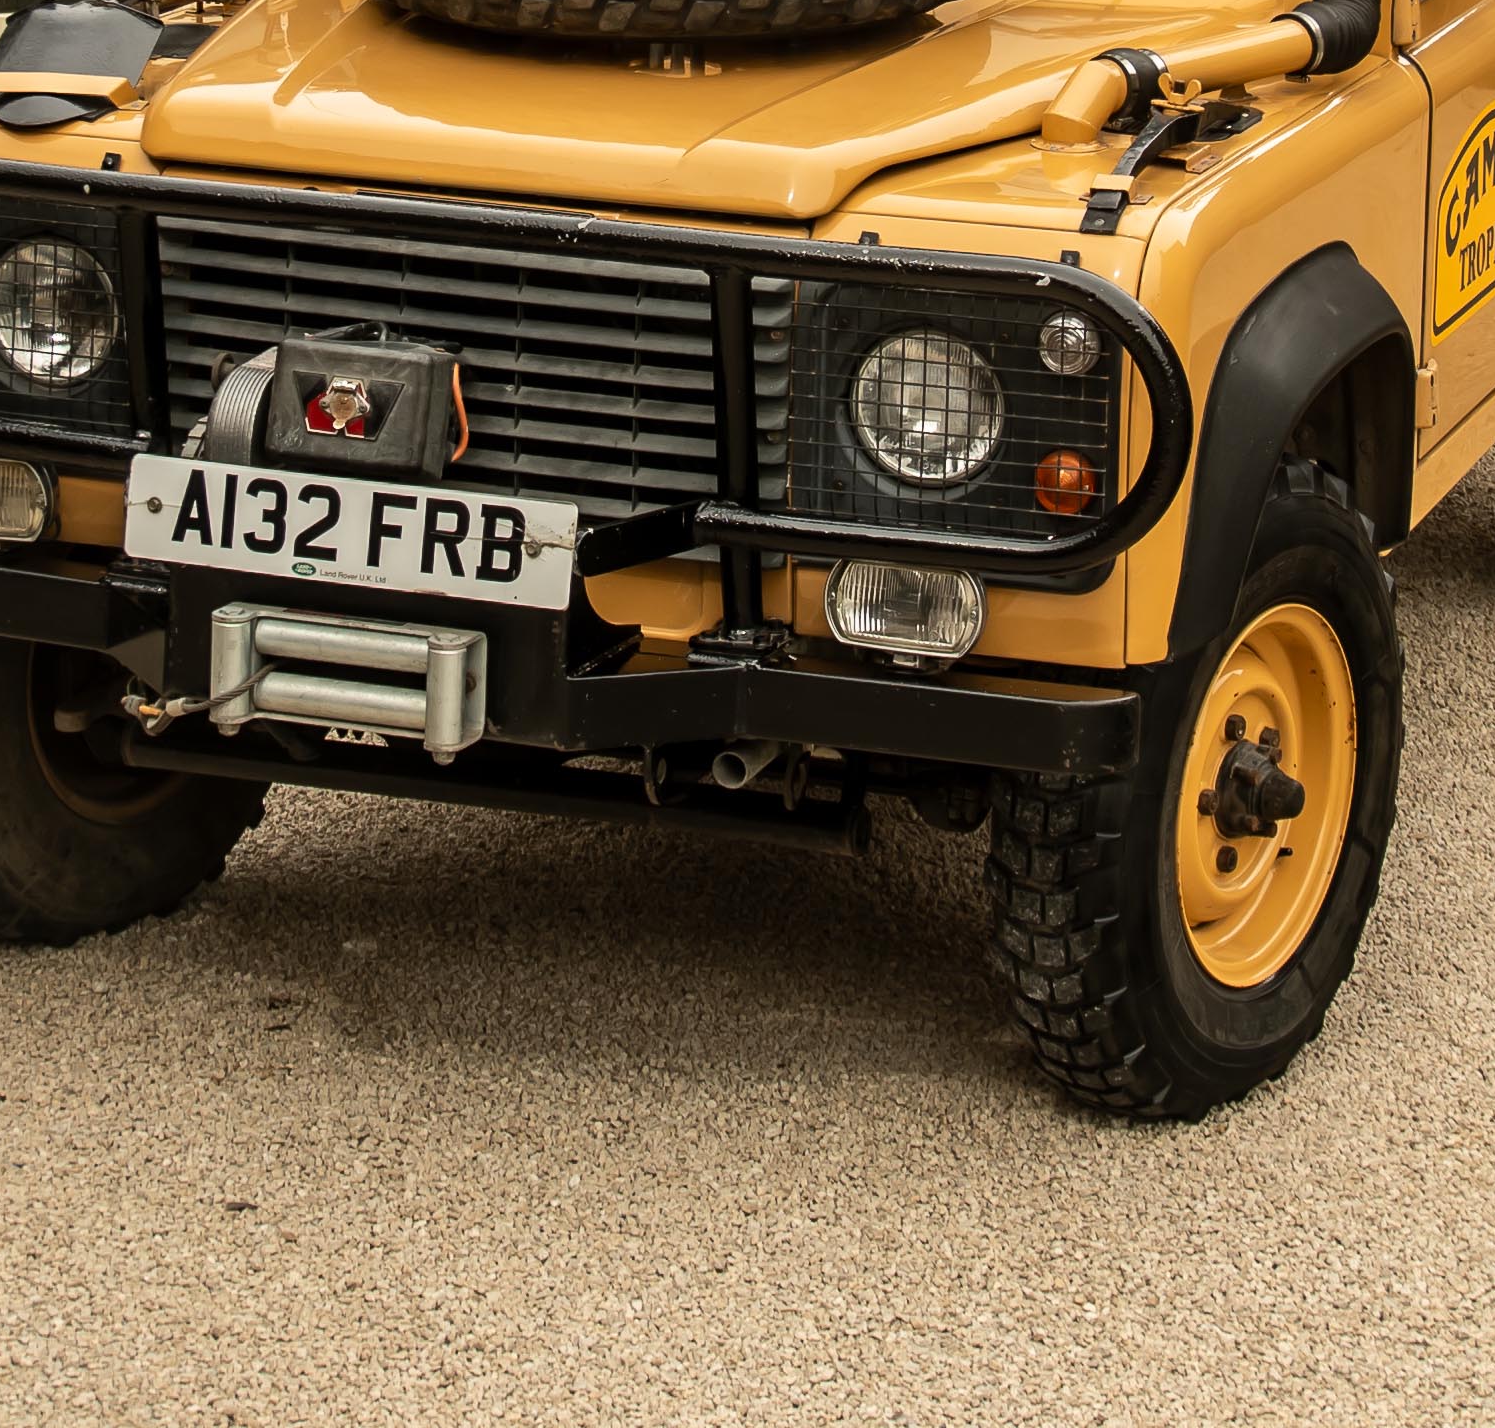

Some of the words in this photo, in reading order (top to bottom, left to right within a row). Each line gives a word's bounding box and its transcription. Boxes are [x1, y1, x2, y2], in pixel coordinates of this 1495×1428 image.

[171, 469, 341, 562] A132
[366, 491, 526, 583] FRB
[320, 569, 337, 578] Land
[338, 571, 358, 581] Rover
